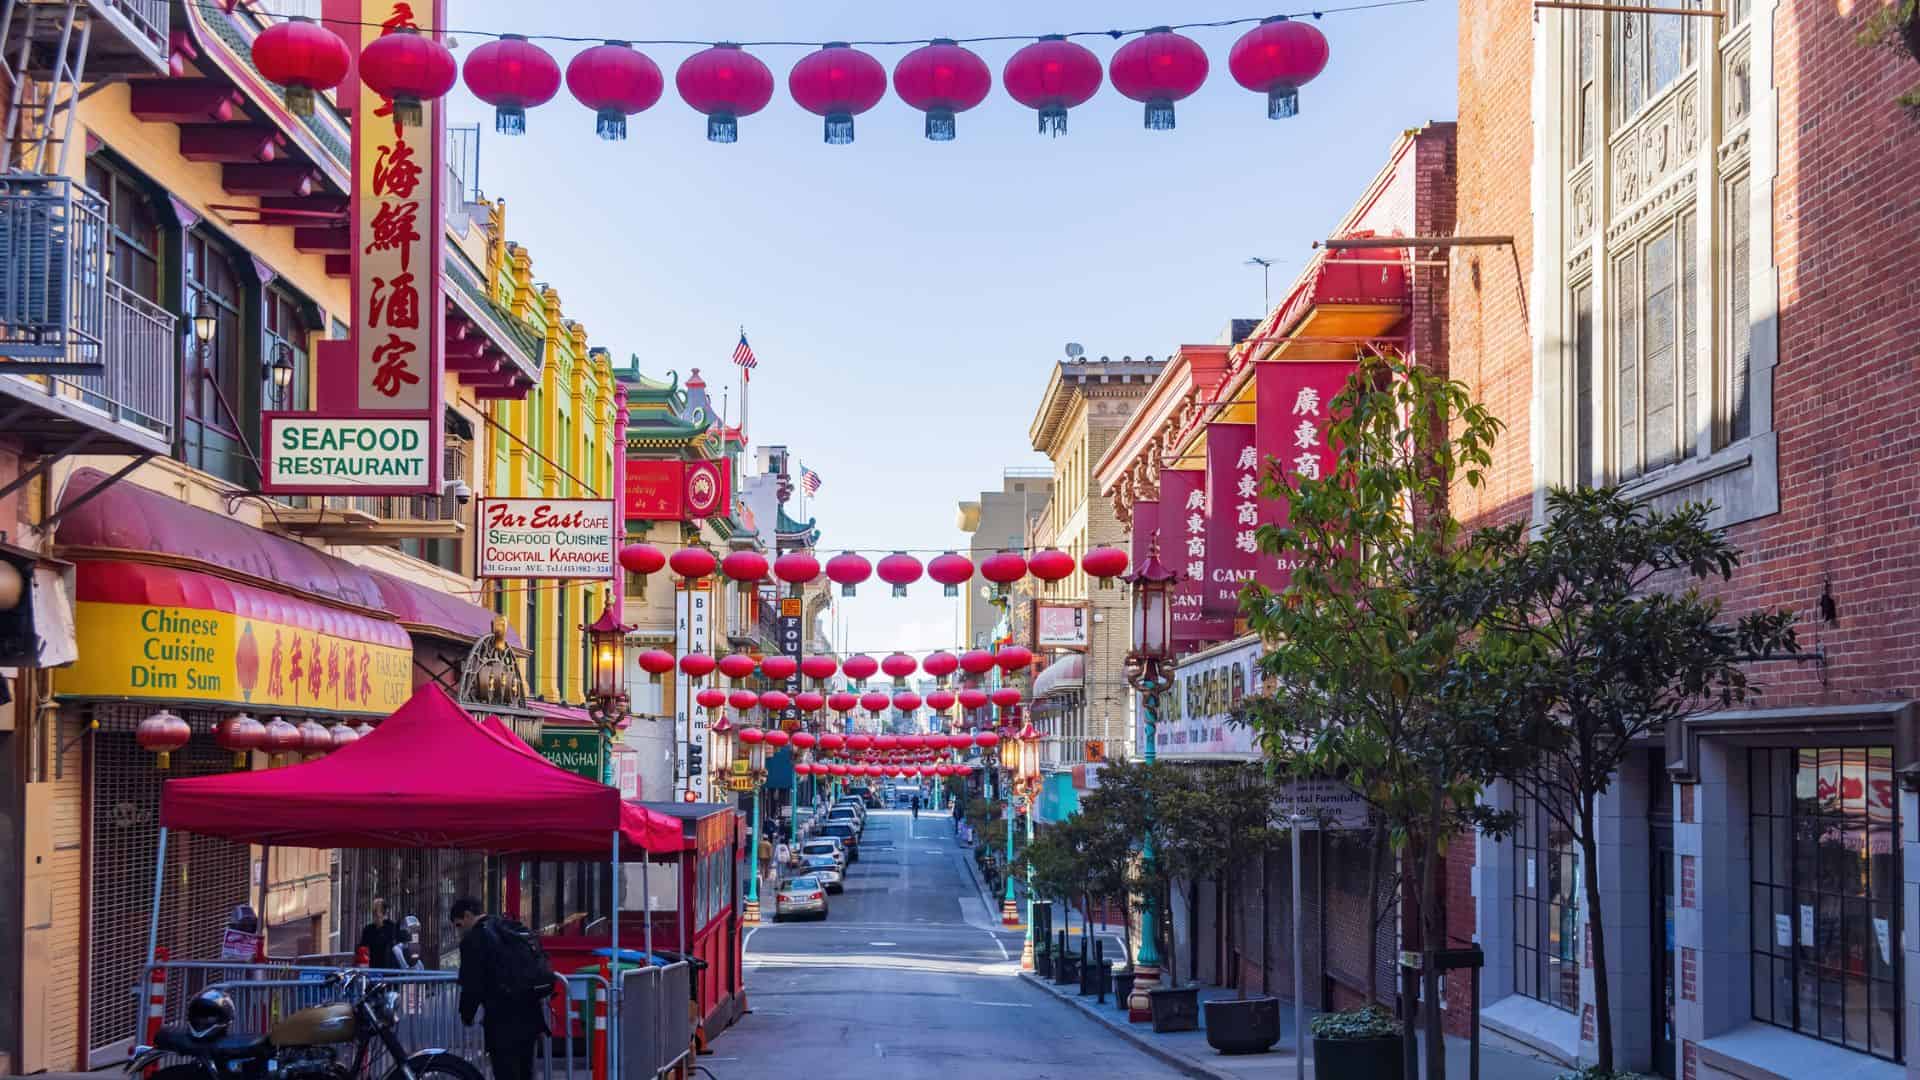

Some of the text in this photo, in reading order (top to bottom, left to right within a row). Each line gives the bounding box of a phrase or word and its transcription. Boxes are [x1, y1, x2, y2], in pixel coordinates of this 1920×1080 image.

[365, 2, 423, 397] 海鮮酒家
[282, 427, 419, 451] SEAFOOD
[1292, 387, 1321, 481] 廣東商
[278, 457, 424, 476] RESTAURANT
[487, 503, 527, 529] Far
[530, 504, 583, 529] East
[140, 609, 219, 636] Chinese
[143, 638, 215, 663] Cuisine
[786, 618, 798, 660] FOU
[130, 665, 221, 692] Dim Sum
